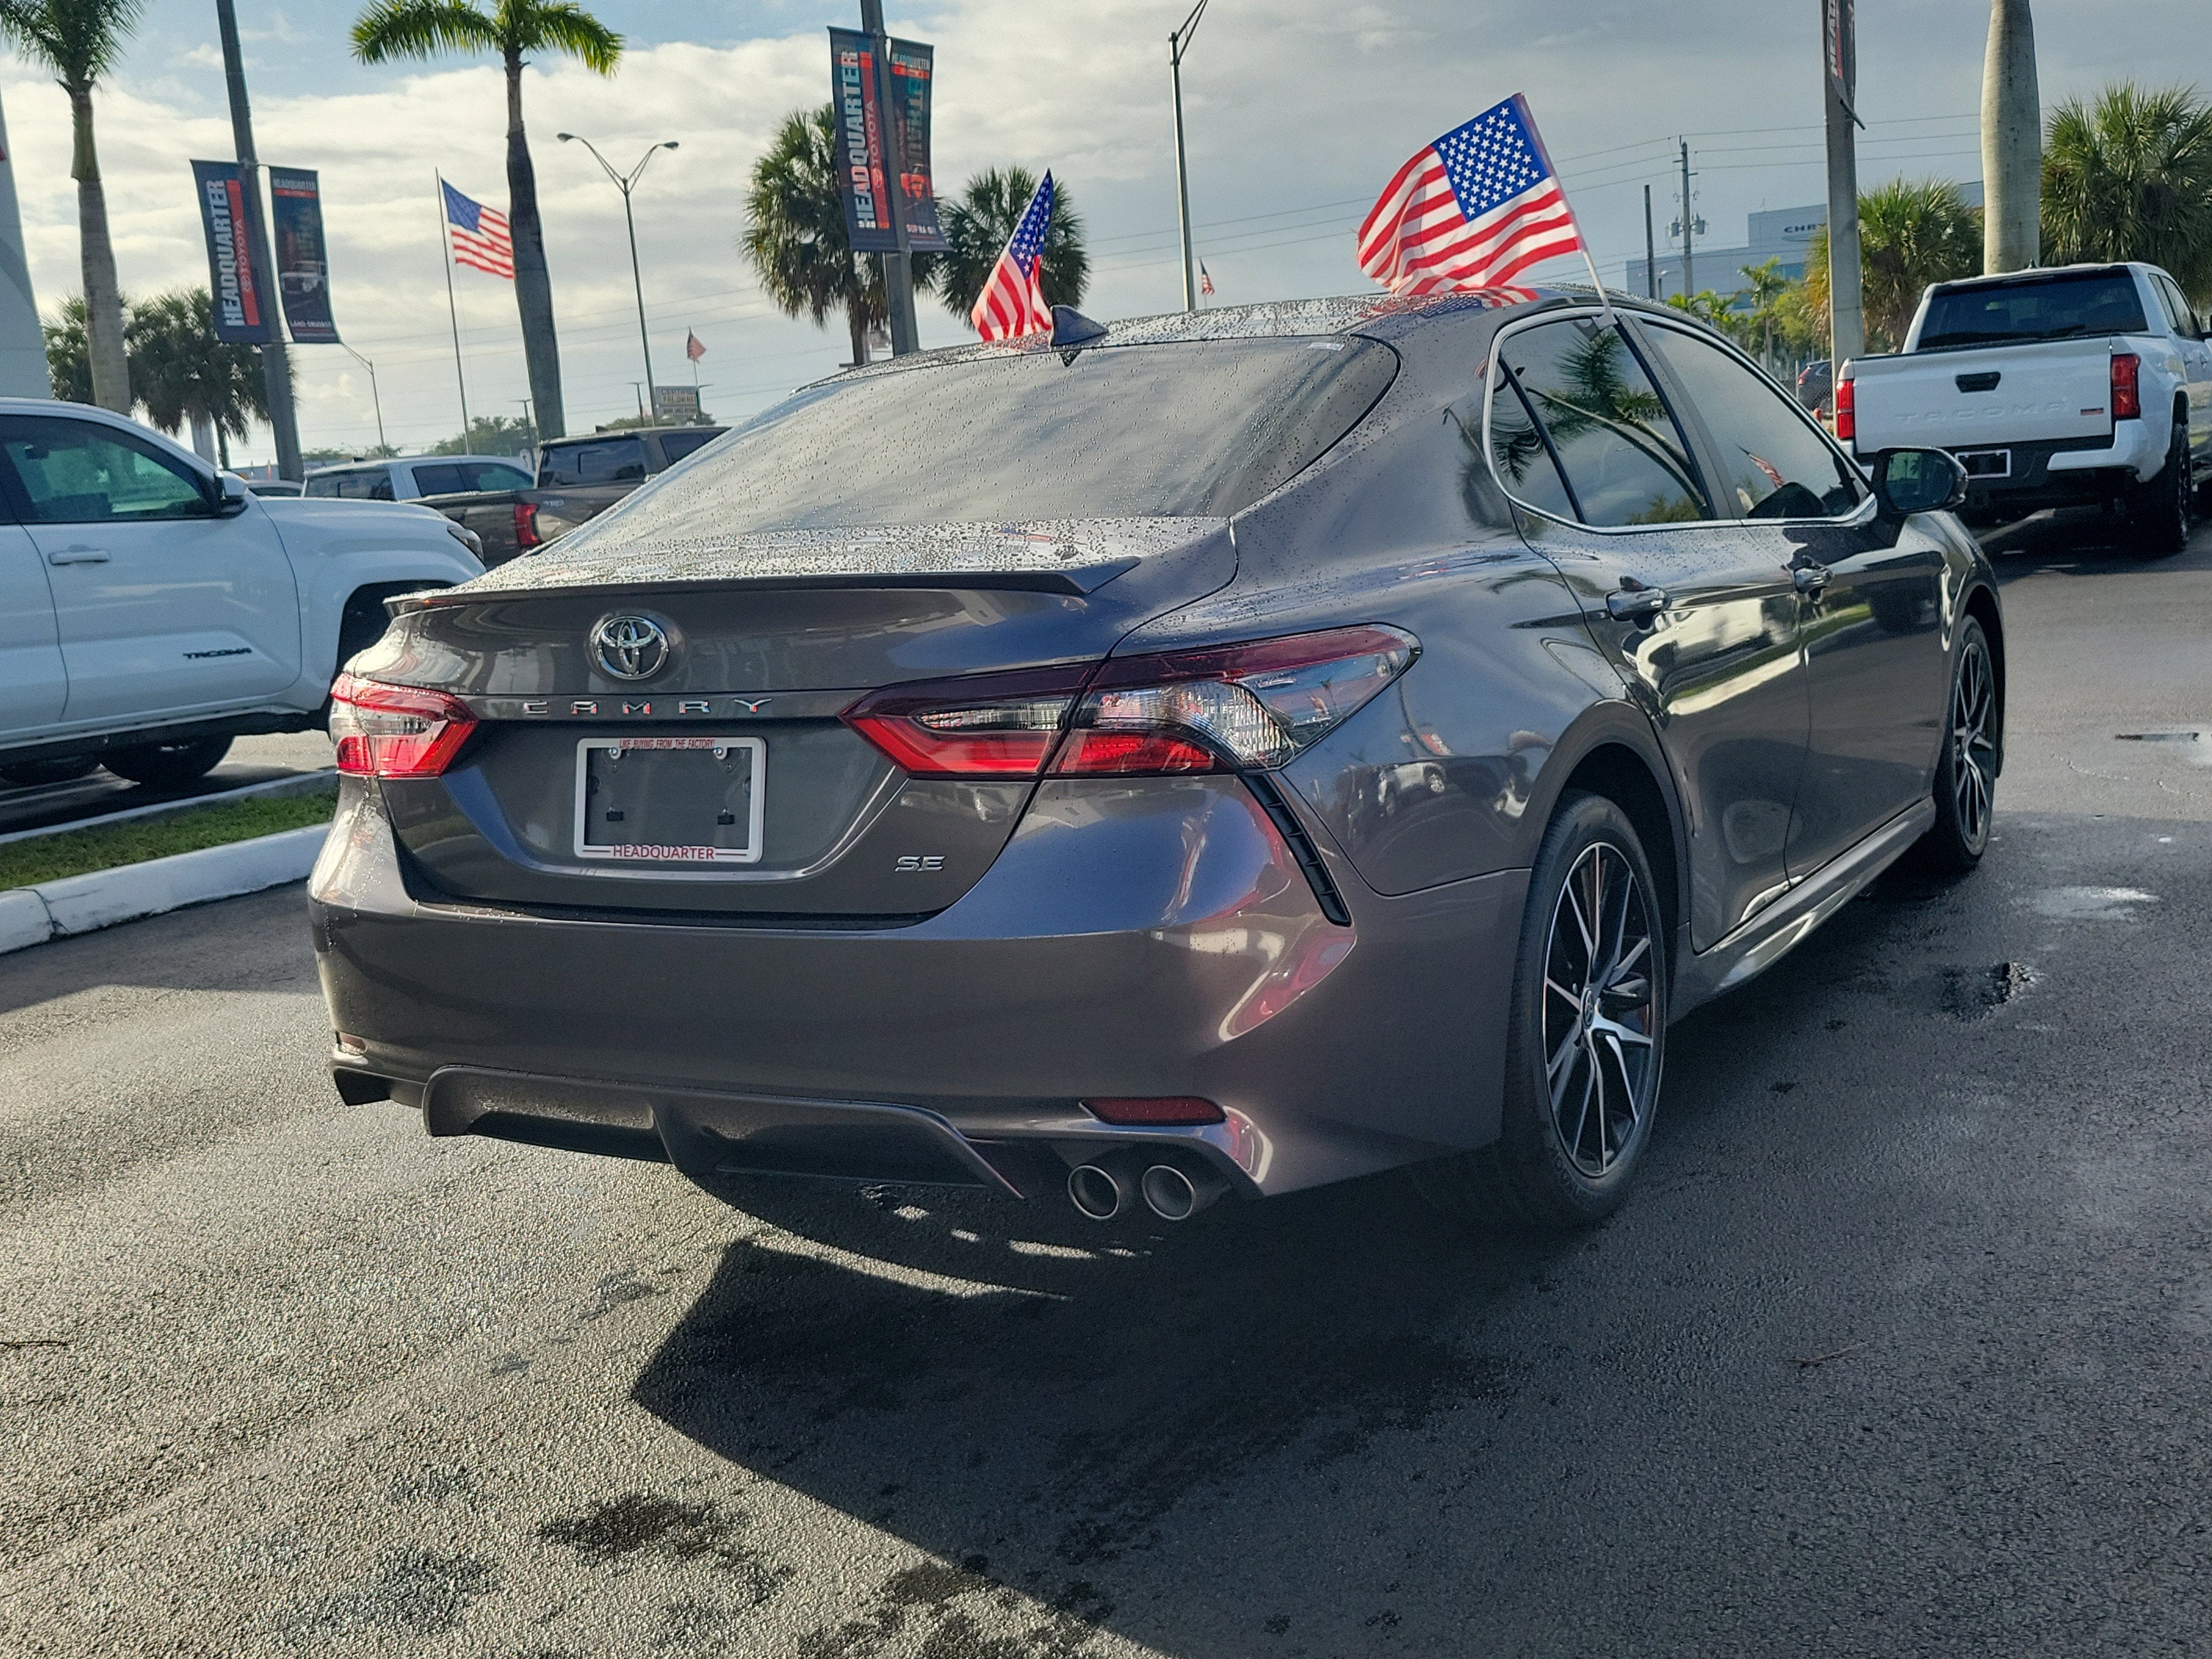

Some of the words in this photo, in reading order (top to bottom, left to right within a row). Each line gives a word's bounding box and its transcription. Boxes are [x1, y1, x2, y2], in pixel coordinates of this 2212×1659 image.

[840, 52, 876, 229] HEADQUARTER
[866, 100, 879, 165] TOYOTA
[206, 179, 246, 327] HEADQUARTER
[234, 218, 251, 278] TOYOTA
[1895, 401, 2068, 425] TACOMA
[182, 647, 252, 659] TACOMA
[620, 739, 630, 748] LIKE
[634, 739, 653, 748] BUYING
[656, 739, 672, 748] FROM
[675, 739, 686, 748] THE
[689, 739, 715, 749] FACTORY!
[613, 844, 715, 859] HEADQUARTER
[895, 855, 946, 873] SE
